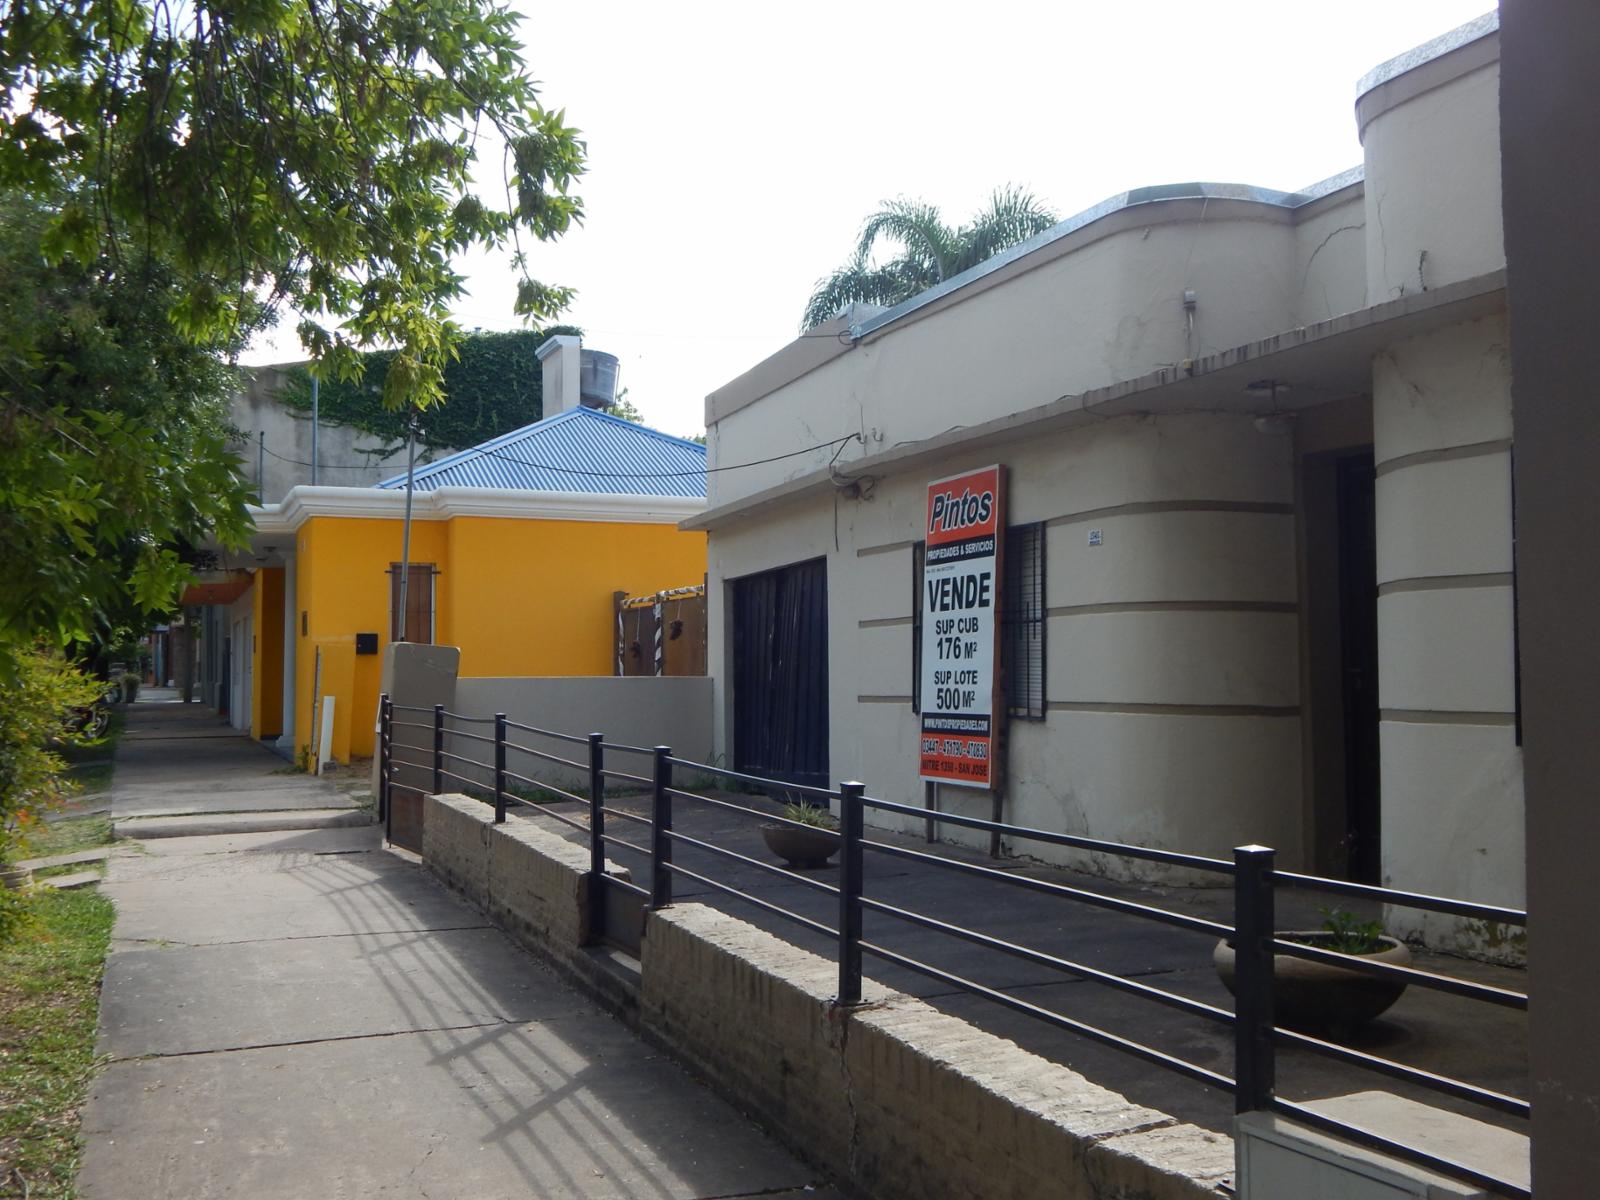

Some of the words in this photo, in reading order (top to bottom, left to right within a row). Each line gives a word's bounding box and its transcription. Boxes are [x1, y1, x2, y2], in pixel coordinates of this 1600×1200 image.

[929, 487, 993, 534] Pintos
[927, 546, 959, 561] PROPIEDADES
[960, 544, 965, 555] &
[965, 540, 994, 554] SERVICIOS
[928, 572, 991, 613] VENDE
[935, 618, 955, 635] SUP
[957, 617, 979, 634] CUB
[937, 636, 961, 660] 176
[934, 670, 952, 685] SUP
[954, 670, 978, 685] LOTE
[936, 687, 960, 710] 500
